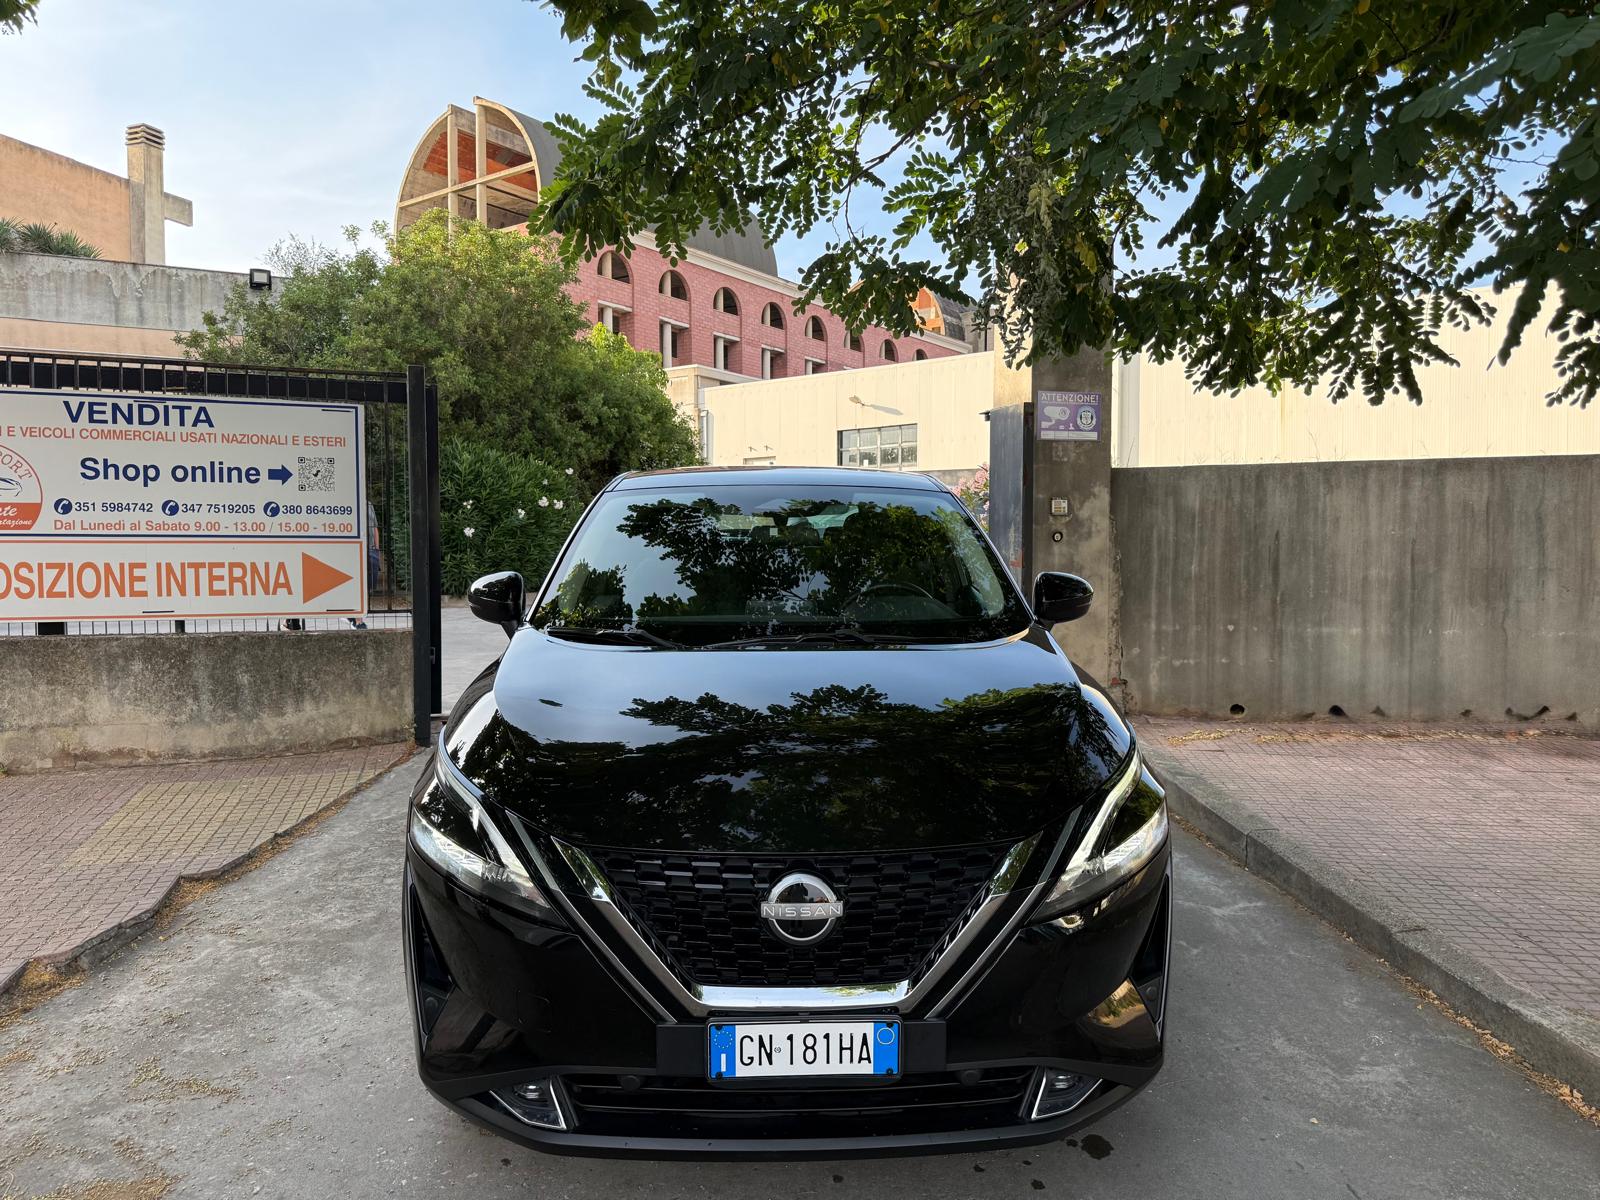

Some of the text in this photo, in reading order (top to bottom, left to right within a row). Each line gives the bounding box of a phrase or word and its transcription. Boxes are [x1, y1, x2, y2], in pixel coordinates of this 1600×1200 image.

[1041, 392, 1099, 403] ATTENZIONE!
[62, 400, 215, 428] VENDITA
[7, 425, 16, 437] E
[20, 426, 75, 439] VEICOLI
[79, 428, 176, 442] COMMERCIALI
[180, 431, 217, 444] USATI
[221, 433, 288, 446] NAZIONALI
[291, 435, 300, 446] E
[303, 435, 346, 448] ESTERI
[0, 451, 33, 480] ORT
[79, 457, 261, 487] Shop online
[74, 501, 153, 513] 351 5984742
[181, 503, 256, 515] 347 7519205
[281, 504, 353, 516] 380 8643699
[53, 519, 76, 531] Dal
[129, 520, 141, 532] al
[145, 520, 191, 533] Sabato
[194, 521, 221, 532] 9.00
[233, 521, 266, 533] 13.00
[277, 522, 310, 533] 15.00
[321, 522, 353, 534] 19.00
[155, 561, 294, 598] INTERNA
[762, 904, 843, 918] NISSAN
[739, 1034, 773, 1066] GN
[786, 1032, 872, 1066] 181HA
